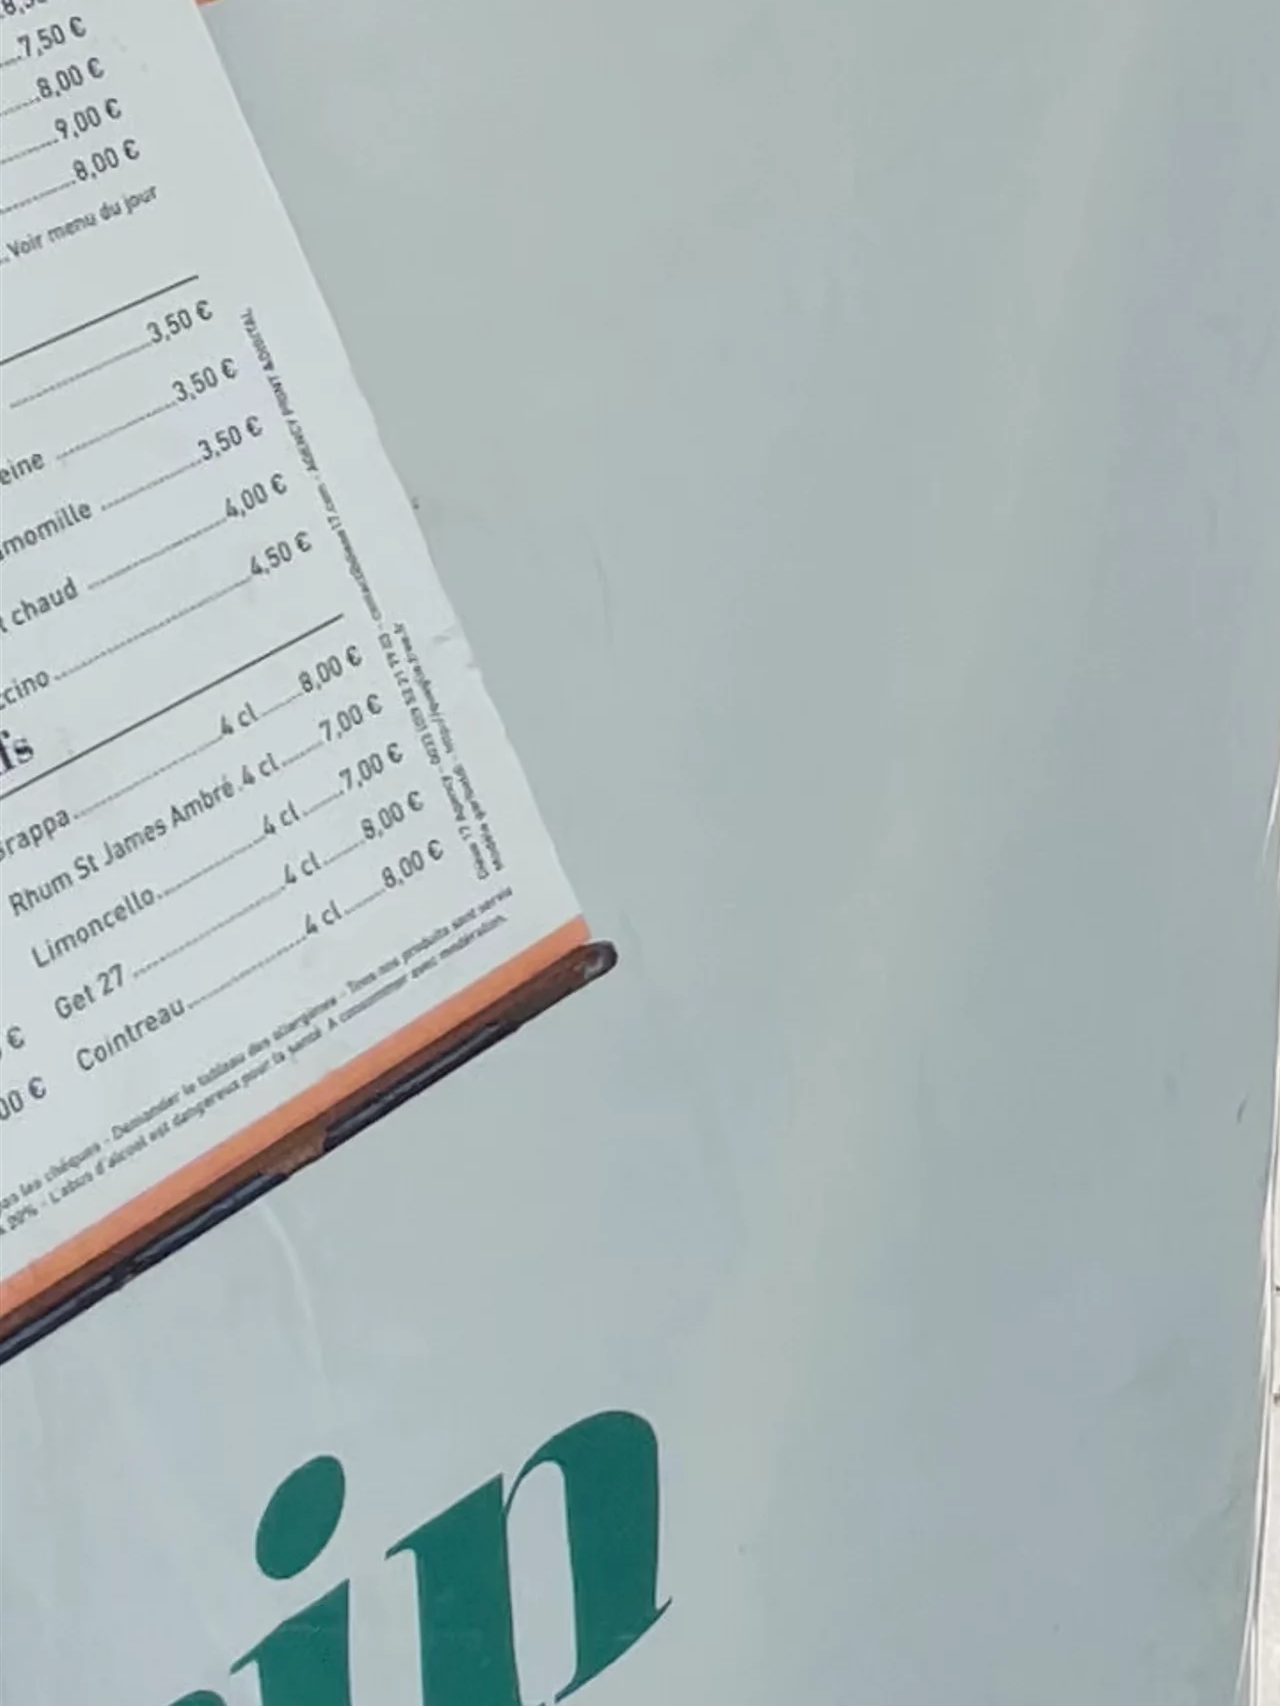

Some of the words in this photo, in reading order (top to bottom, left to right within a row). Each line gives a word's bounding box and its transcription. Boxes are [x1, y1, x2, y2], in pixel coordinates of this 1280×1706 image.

[18, 23, 65, 57] 7,50
[70, 16, 87, 38] €
[37, 64, 83, 99] 8,00
[87, 57, 105, 79] €
[54, 105, 101, 139] 9,00
[105, 98, 122, 120] €
[73, 147, 119, 182] 8,00
[123, 139, 140, 161] €
[7, 234, 43, 259] Voir
[48, 213, 97, 243] menu
[99, 201, 122, 221] du
[124, 185, 157, 216] jour
[147, 308, 193, 344] 3,50
[196, 299, 214, 321] €
[172, 366, 218, 403] 3,50
[221, 357, 239, 379] €
[198, 425, 243, 462] 3,50
[246, 415, 263, 438] €
[11, 576, 79, 626] chaud
[225, 482, 268, 518] 4,00
[271, 473, 288, 495] €
[251, 541, 293, 576] 4,50
[295, 530, 313, 553] €
[237, 701, 260, 728] cl
[299, 655, 343, 693] 8,00
[346, 645, 363, 668] €
[8, 872, 73, 917] Rhum
[74, 854, 99, 880] St
[104, 818, 167, 866] James
[171, 774, 235, 828] Ambré
[258, 752, 280, 778] cl
[318, 703, 363, 742] 7,00
[366, 693, 383, 716] €
[32, 887, 155, 969] Limoncello
[279, 799, 301, 827] cl
[338, 752, 384, 791] 7,00
[387, 742, 404, 764] €
[54, 984, 96, 1020] Get
[96, 963, 123, 996] 27
[300, 851, 322, 877] cl
[361, 801, 405, 840] 8,00
[407, 790, 424, 813] €
[77, 998, 185, 1071] Cointreau
[321, 899, 343, 926] cl
[381, 849, 425, 889] 8,00
[427, 838, 444, 861] €
[28, 1076, 47, 1100] €
